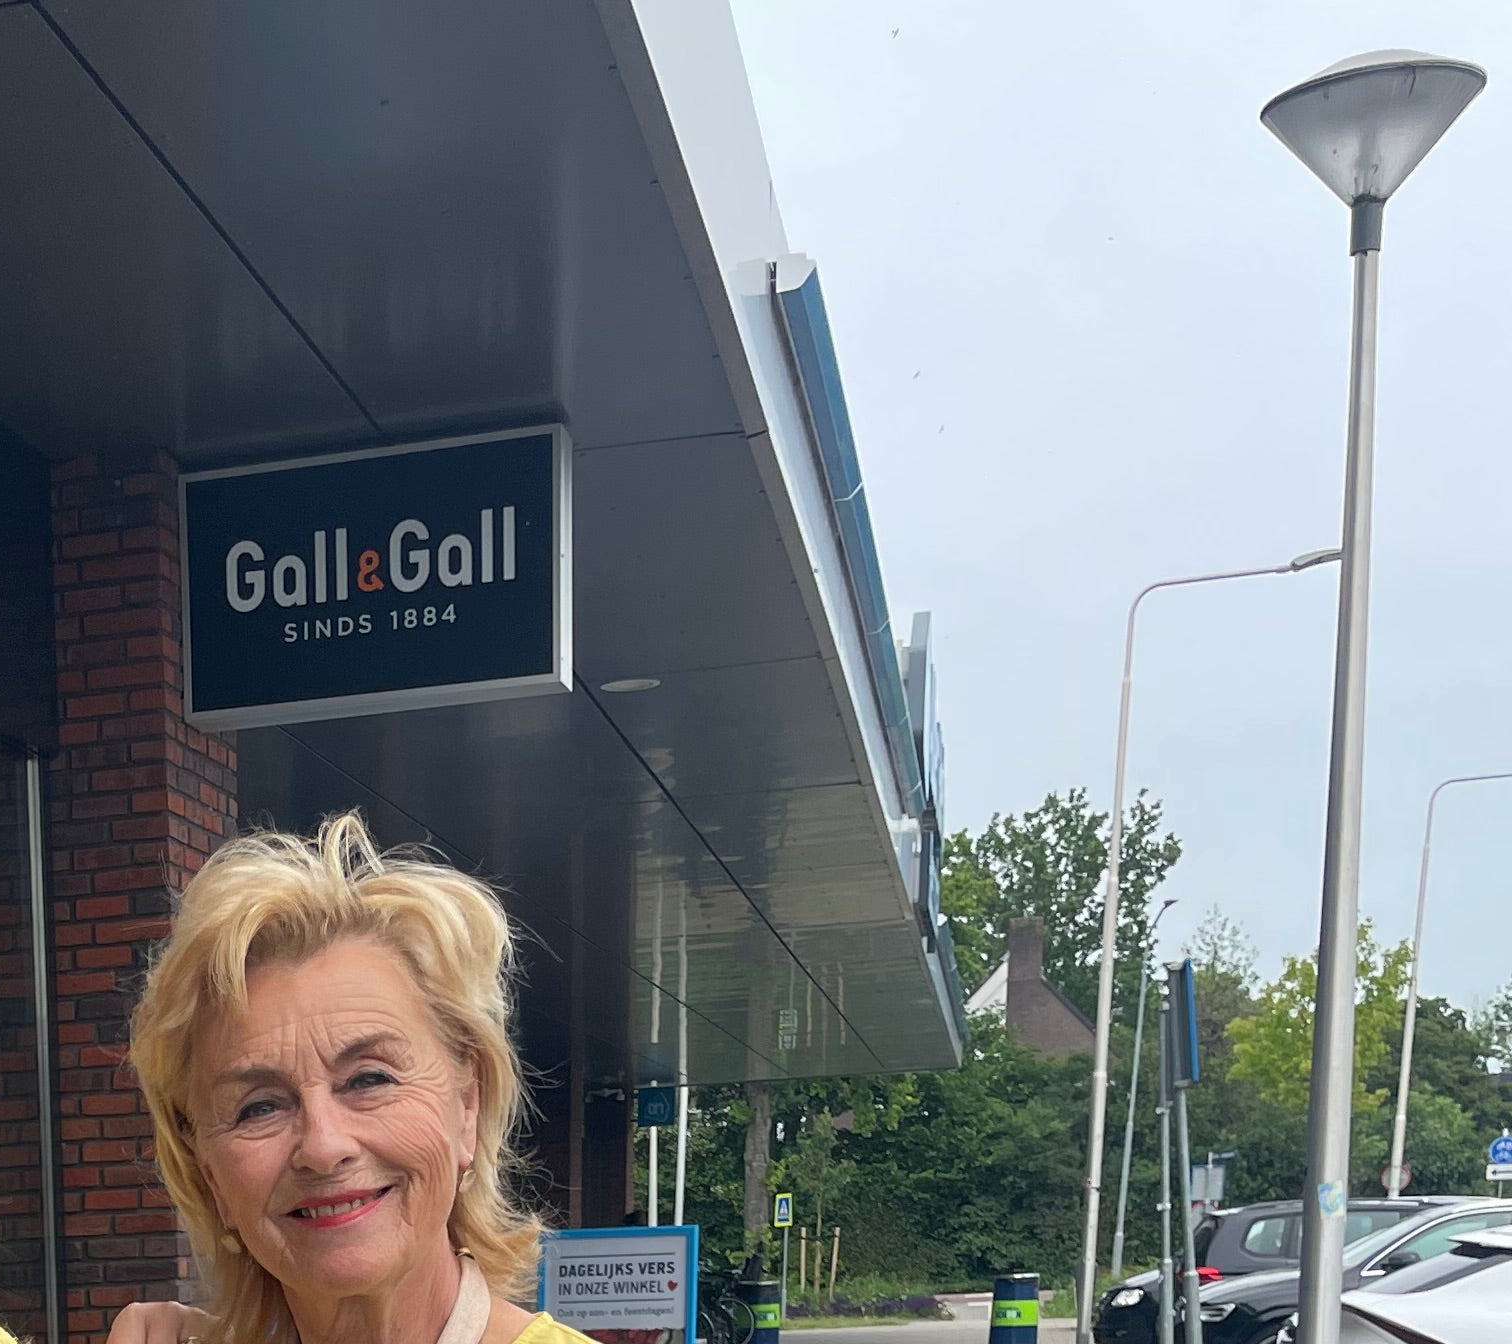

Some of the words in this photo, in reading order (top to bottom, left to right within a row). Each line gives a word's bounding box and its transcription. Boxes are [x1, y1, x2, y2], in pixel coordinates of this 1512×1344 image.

[284, 613, 373, 643] SINDS
[389, 603, 457, 631] 1884
[558, 1262, 634, 1279] DAGELIJKS
[638, 1261, 675, 1275] VERS
[558, 1283, 571, 1296] IN
[575, 1281, 609, 1296] ONZE
[613, 1279, 664, 1294] WINKEL
